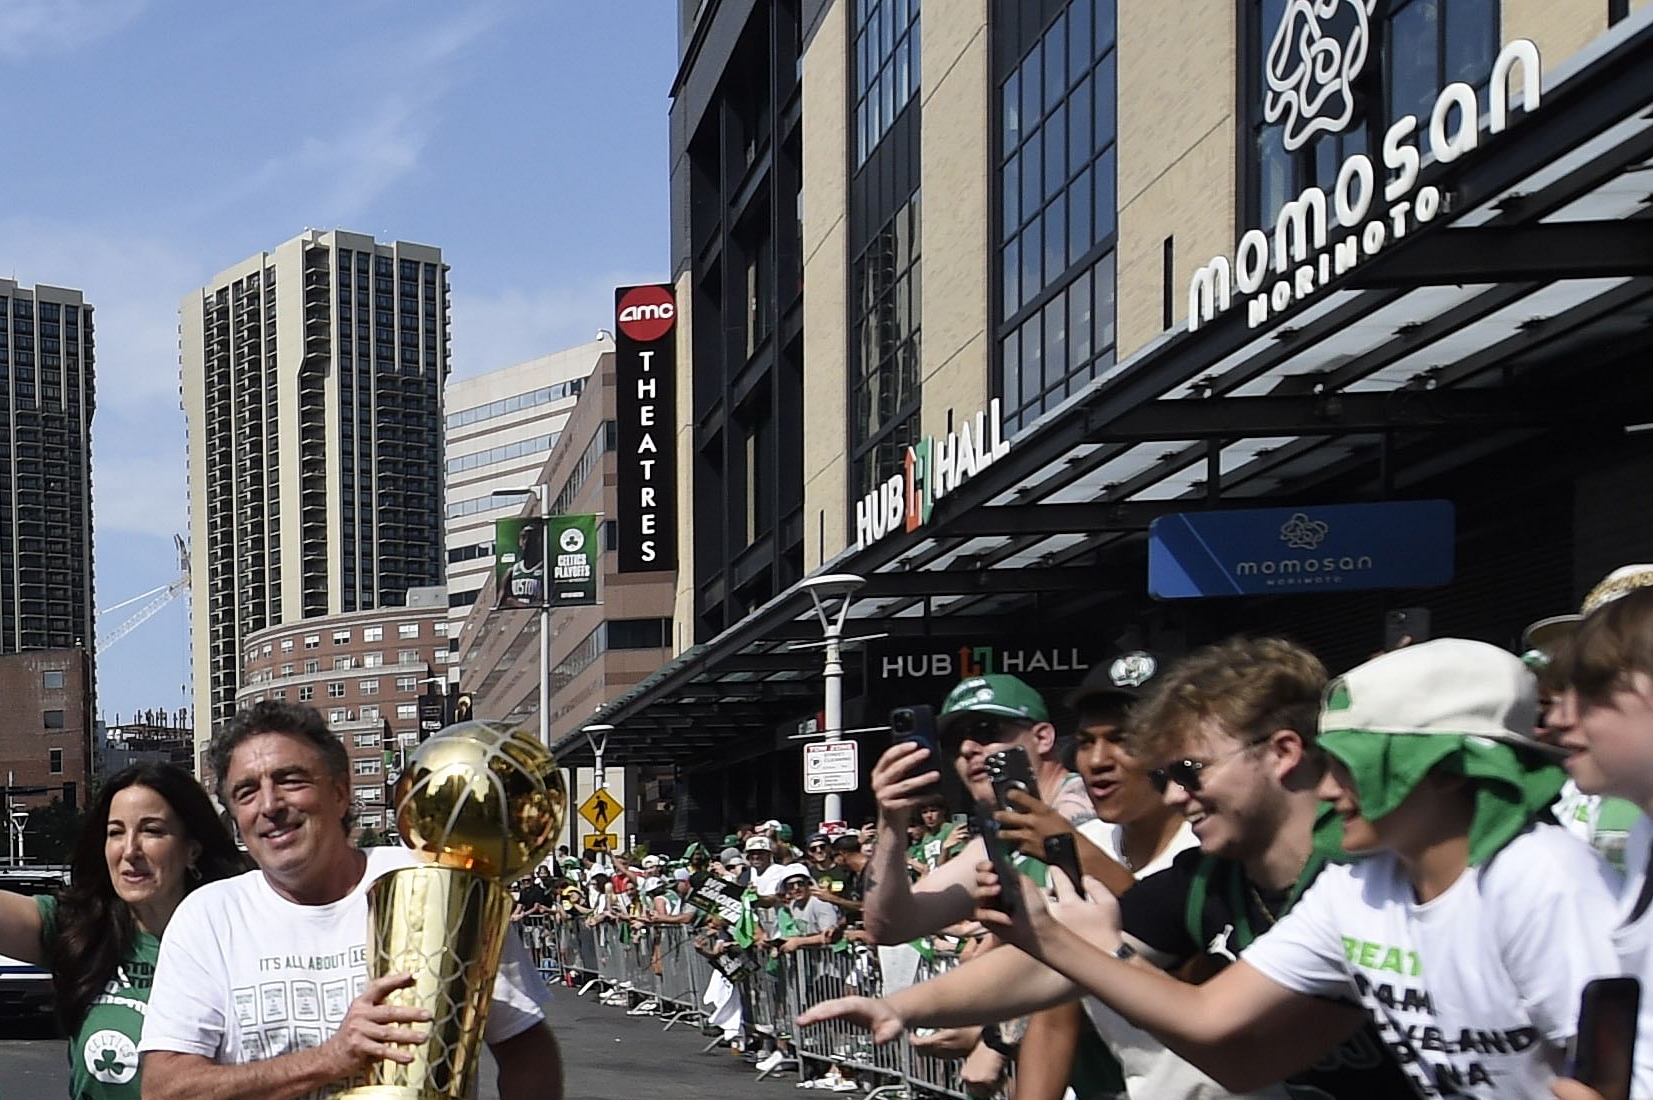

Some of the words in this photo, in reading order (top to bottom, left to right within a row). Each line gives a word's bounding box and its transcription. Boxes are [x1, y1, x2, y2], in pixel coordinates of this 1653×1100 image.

[1188, 38, 1541, 333] momosan
[1248, 186, 1440, 329] MORIMOTO
[618, 302, 675, 322] amc
[637, 351, 658, 562] THEATRES
[856, 473, 905, 552] HUB
[935, 397, 1011, 500] HALL
[1236, 555, 1373, 577] momosan
[881, 653, 953, 679] HUB
[1002, 647, 1089, 673] HALL
[285, 955, 306, 970] ALL
[308, 952, 346, 971] ABOUT
